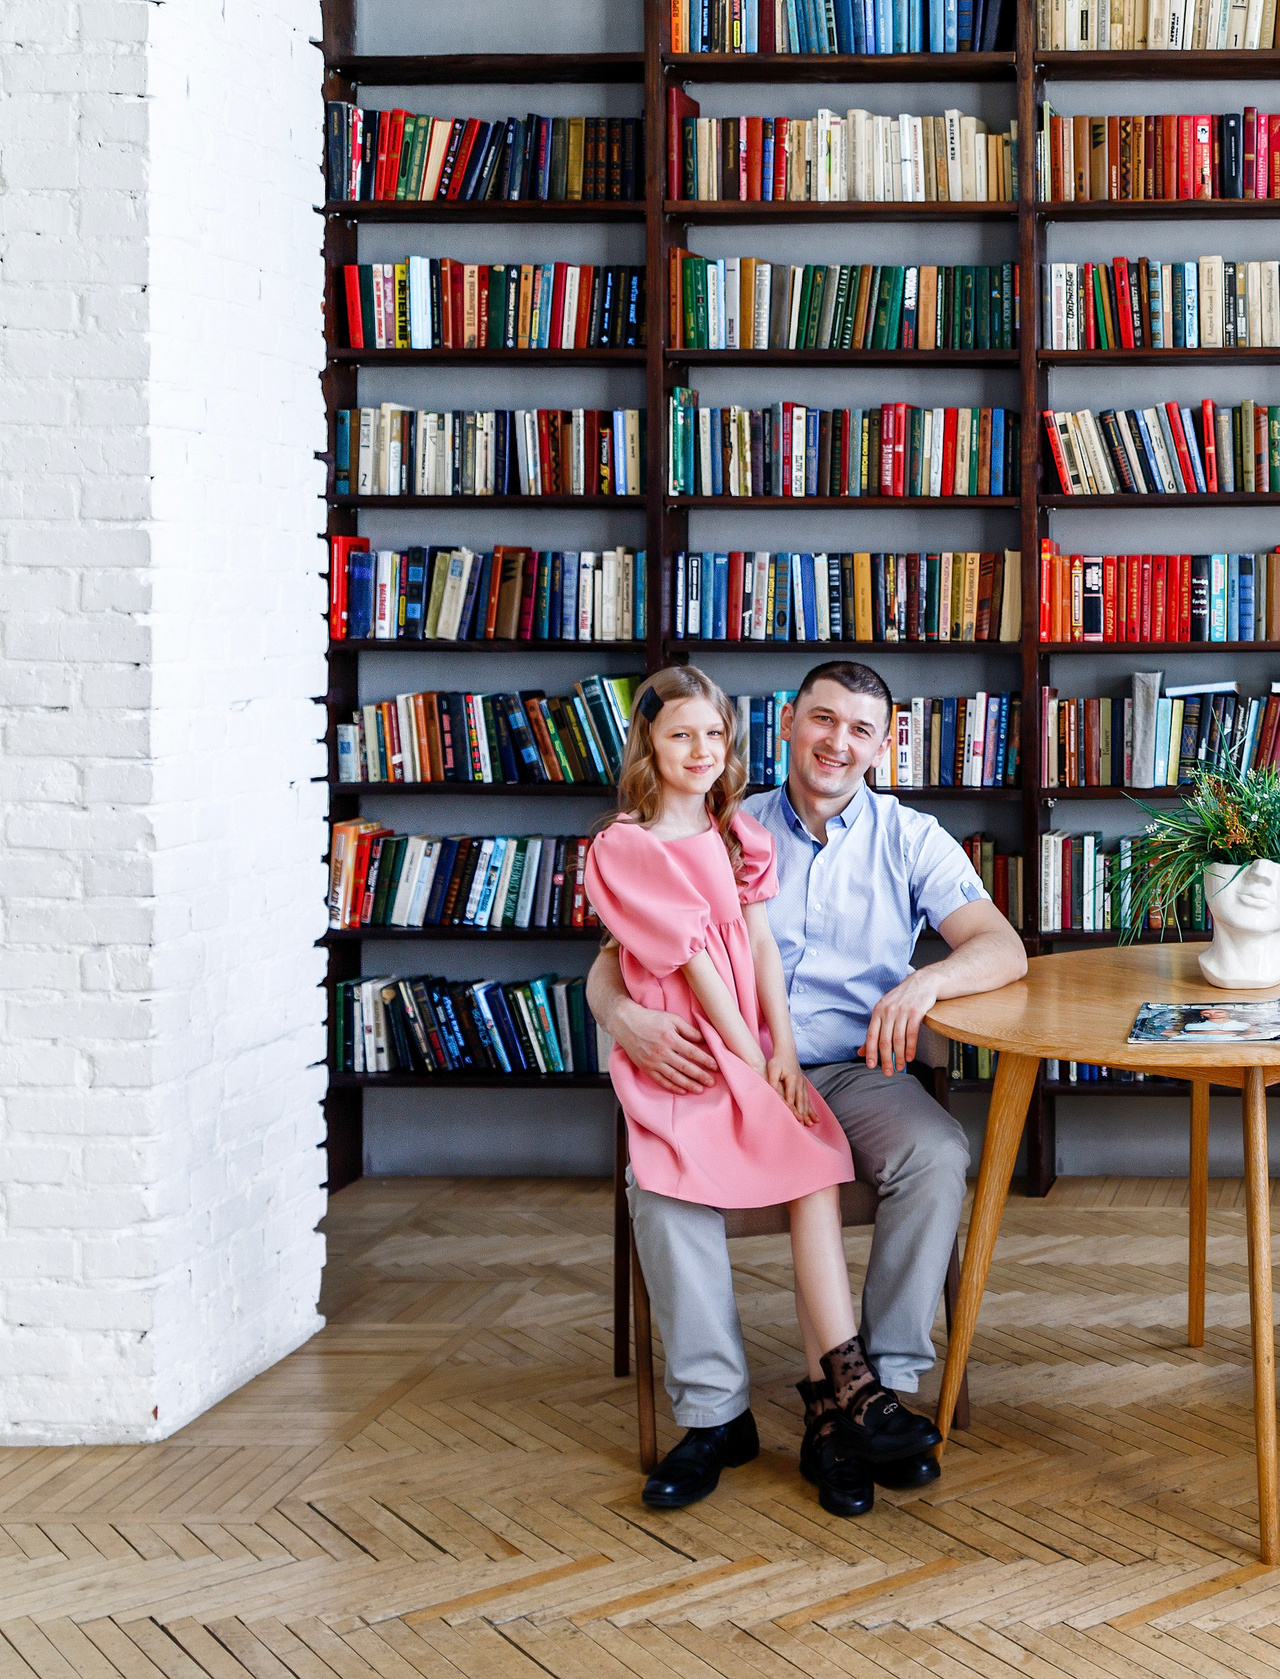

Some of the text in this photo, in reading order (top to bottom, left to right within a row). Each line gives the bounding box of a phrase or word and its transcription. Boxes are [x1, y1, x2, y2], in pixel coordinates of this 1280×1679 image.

[904, 267, 918, 308] Э.ТОПОЛЬ
[882, 444, 893, 486] ЗАЛОЖНИК
[964, 568, 975, 614] В.О.Ключевский
[580, 610, 588, 629] ВРАГИ
[914, 737, 922, 771] ПОЗНАЮ
[503, 852, 525, 918] ЖОРЖ СИМЕНОН
